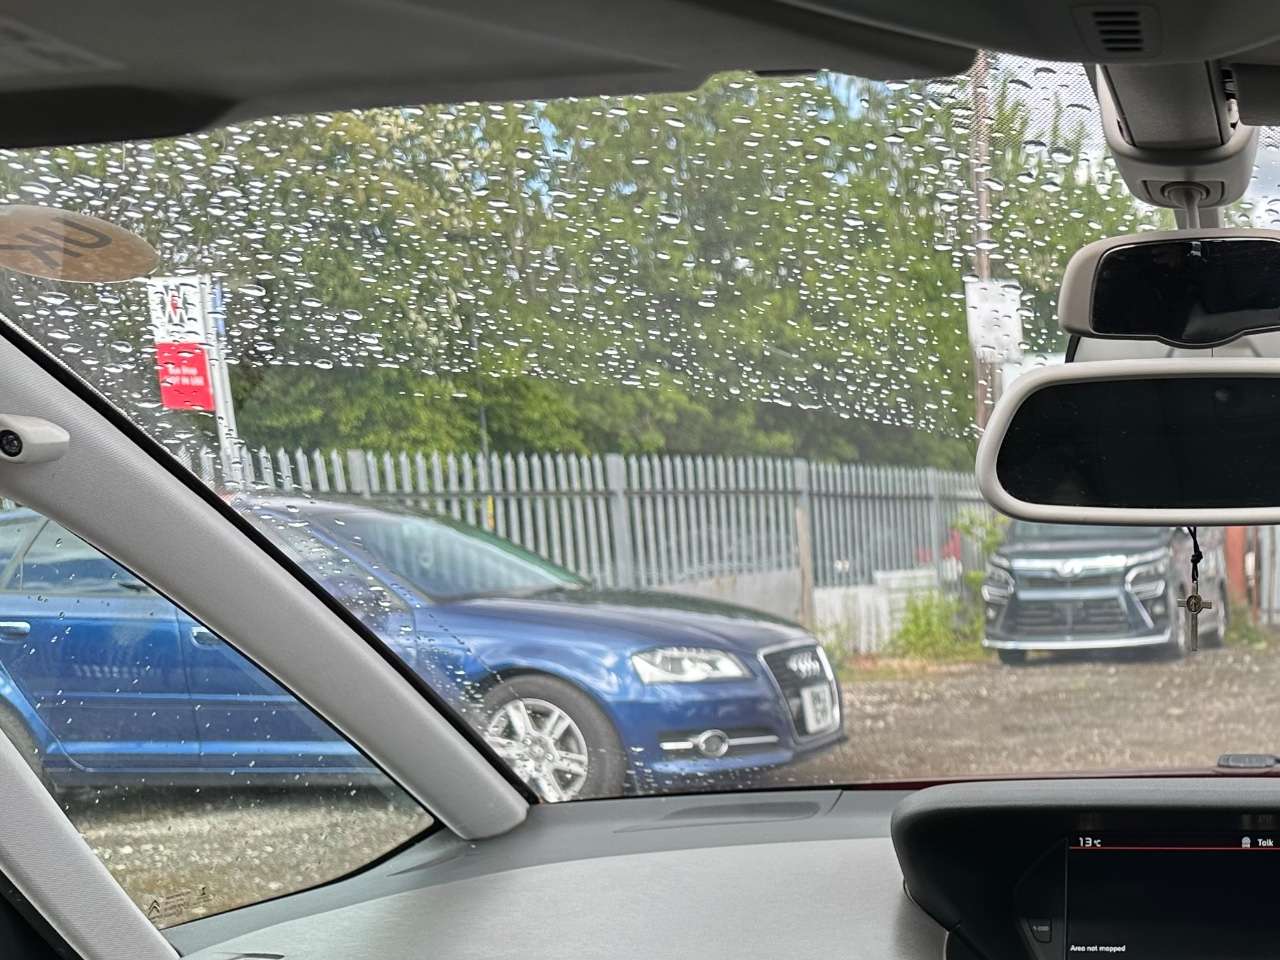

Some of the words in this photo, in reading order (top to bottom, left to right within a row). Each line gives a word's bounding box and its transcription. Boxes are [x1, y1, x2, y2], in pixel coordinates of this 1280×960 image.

[1257, 838, 1274, 847] Talk
[1070, 944, 1086, 952] Area
[1099, 944, 1126, 953] mapped
